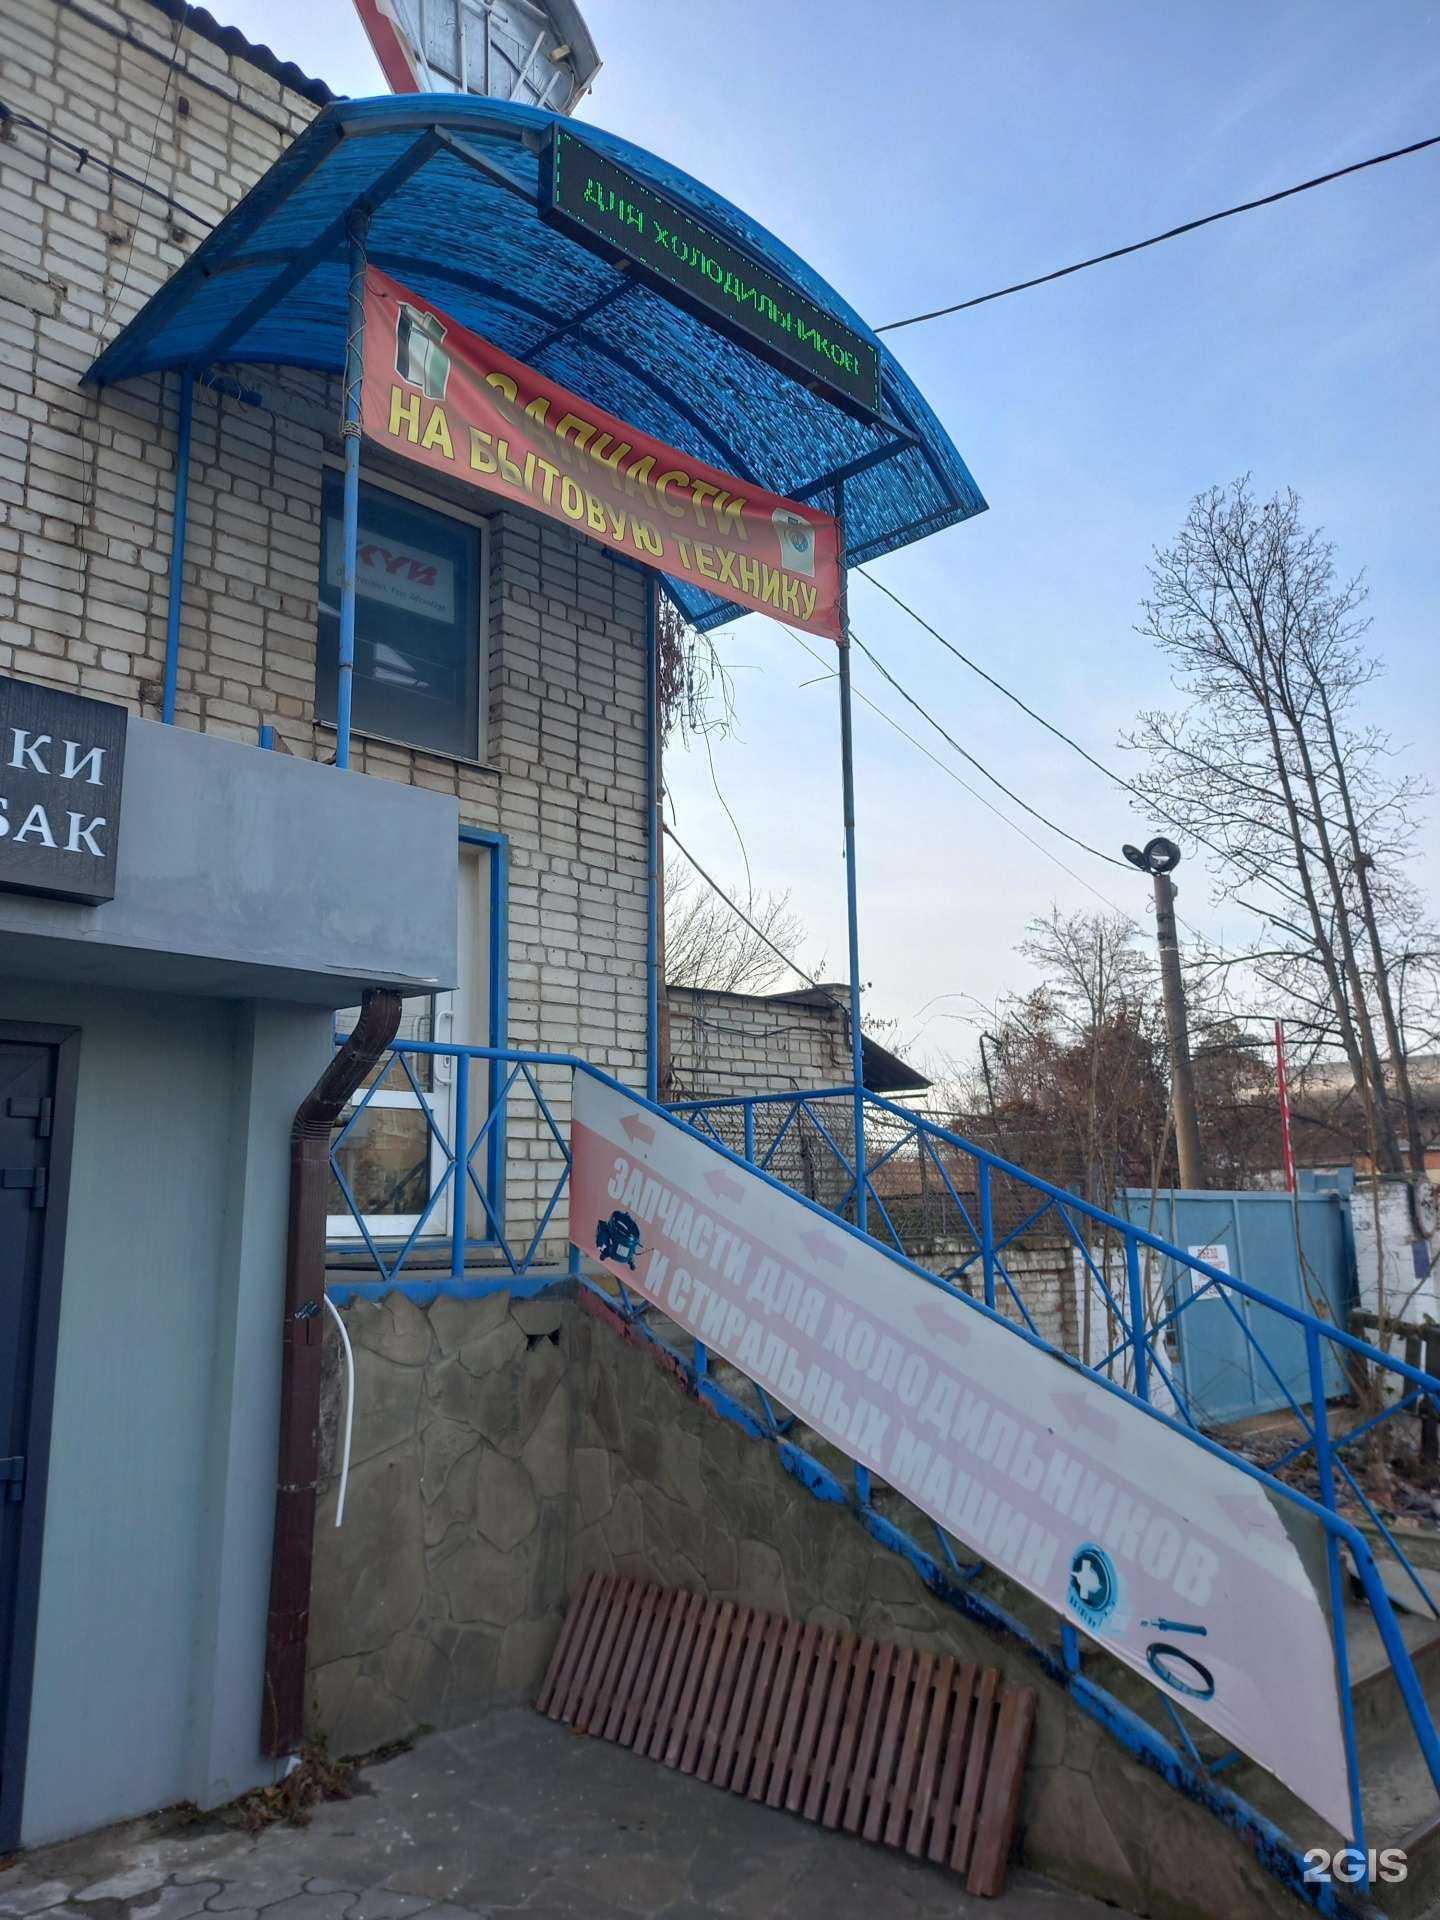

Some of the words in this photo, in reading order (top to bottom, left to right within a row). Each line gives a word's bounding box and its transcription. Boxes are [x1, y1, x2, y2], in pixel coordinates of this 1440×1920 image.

[583, 178, 643, 233] ДЛЯ
[653, 220, 860, 375] ХОЛОДИЛЬНИКОВ
[388, 385, 455, 460] НА
[469, 427, 665, 558] БЫТОВУЮ
[669, 533, 818, 621] ТЕХНИКУ
[485, 371, 750, 543] ЗАПЧАСТИ
[0, 797, 107, 858] АК
[607, 1156, 752, 1286] ЗАПЧАСТИ
[746, 1256, 827, 1336] ДЛЯ
[821, 1308, 1221, 1608] ХОЛОДИЛЬНИКОВ
[643, 1249, 671, 1297] И
[667, 1271, 892, 1461] СТИРАЛЬНЫХ
[889, 1429, 1061, 1588] МАШИН
